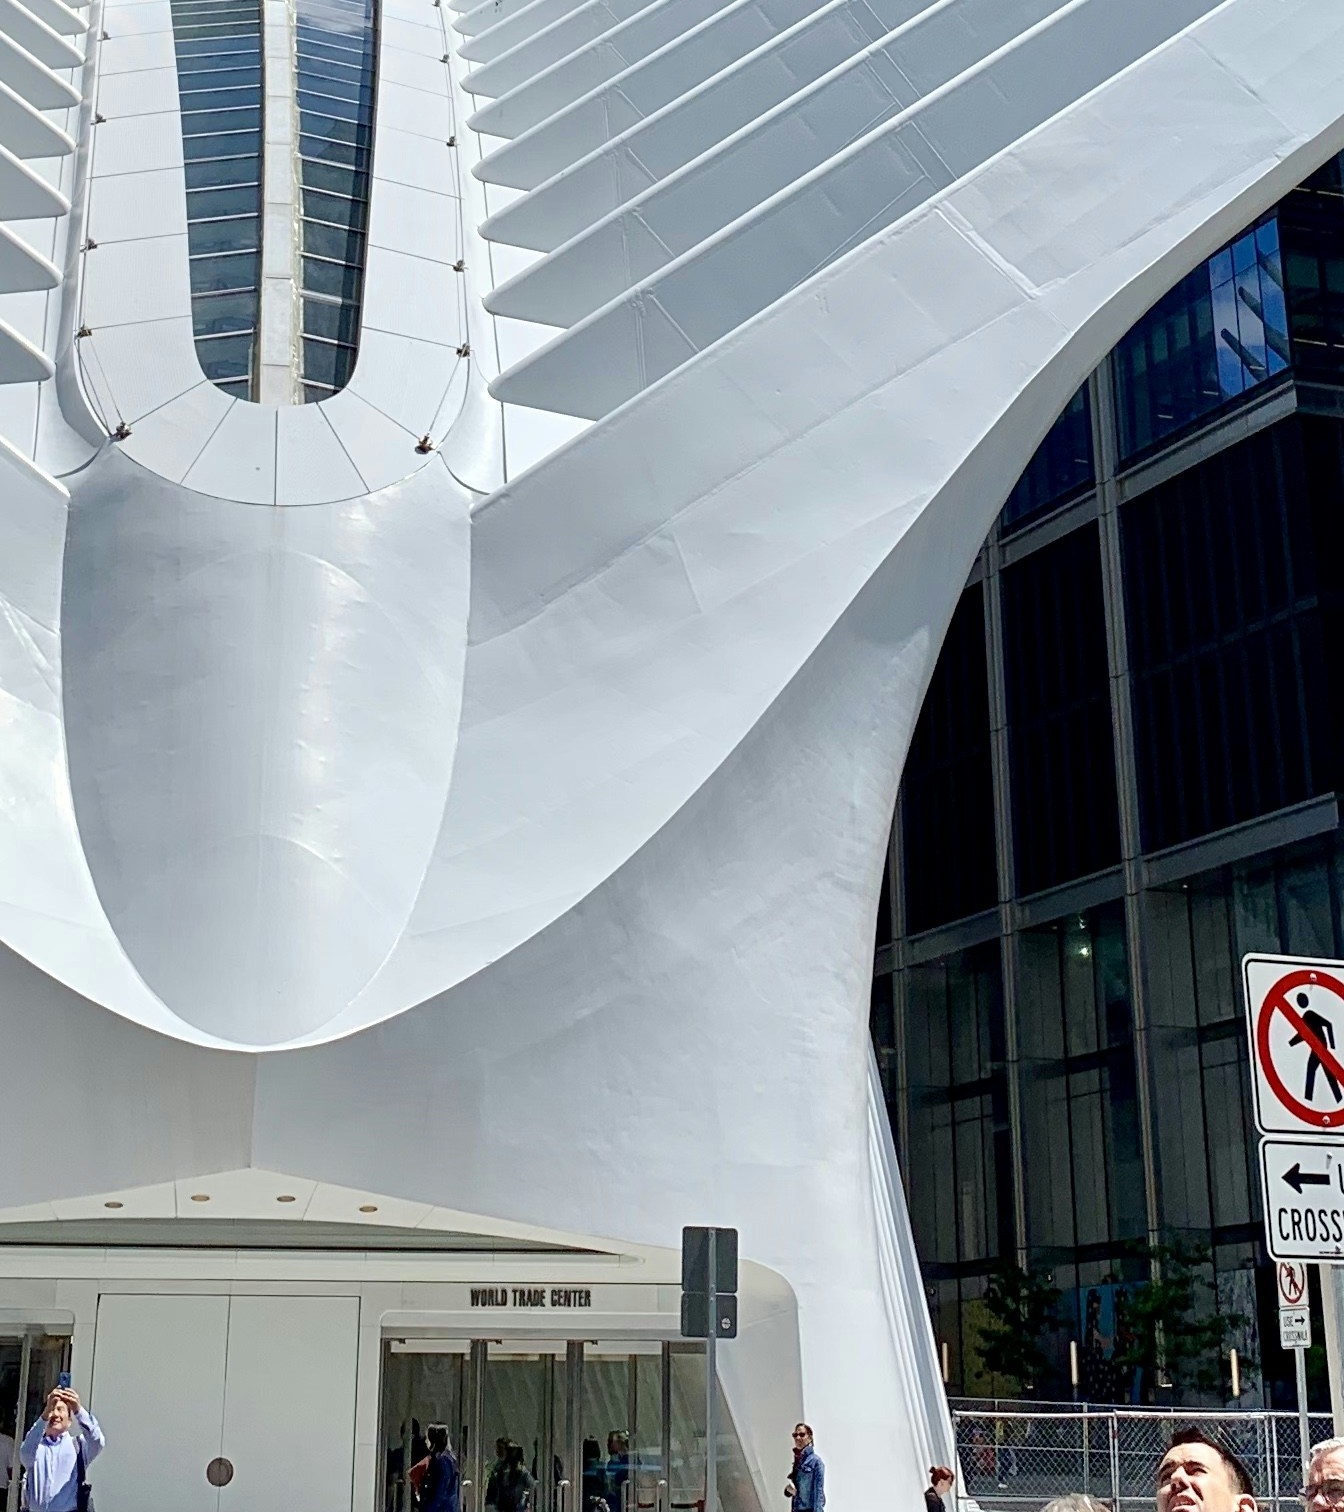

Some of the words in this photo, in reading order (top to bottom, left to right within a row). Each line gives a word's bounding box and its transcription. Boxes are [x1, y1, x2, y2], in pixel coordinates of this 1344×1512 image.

[470, 1288, 507, 1307] WORLD
[512, 1289, 546, 1307] TRADE
[550, 1289, 591, 1307] CENTER
[1283, 1316, 1294, 1328] USE
